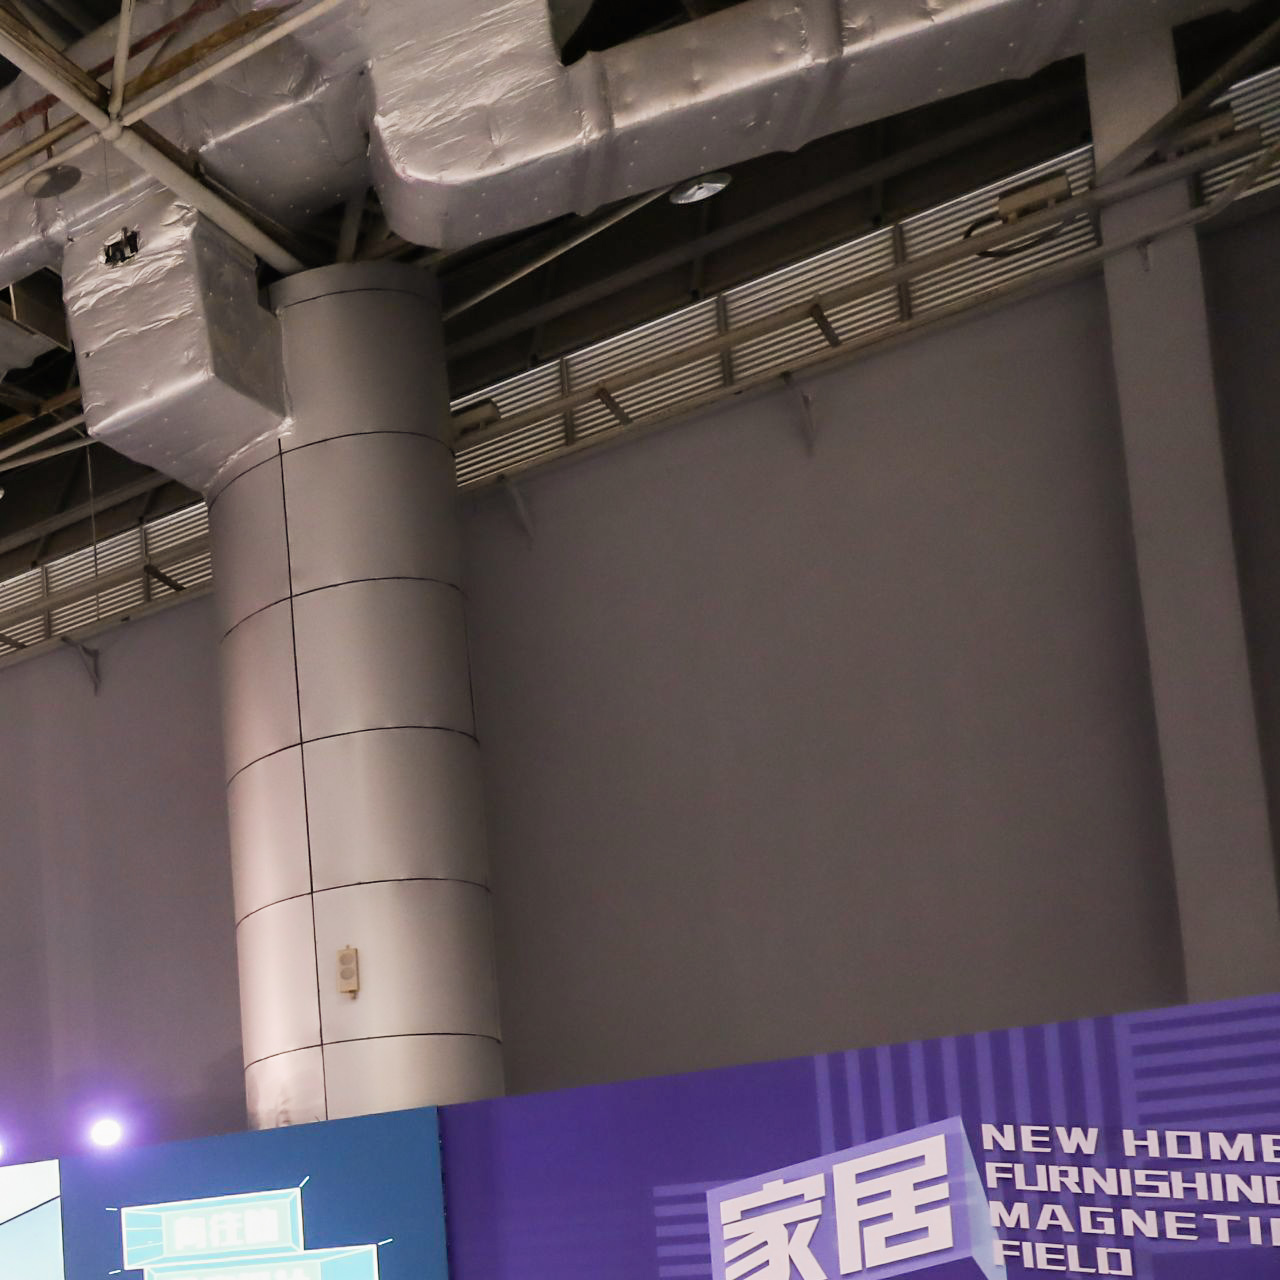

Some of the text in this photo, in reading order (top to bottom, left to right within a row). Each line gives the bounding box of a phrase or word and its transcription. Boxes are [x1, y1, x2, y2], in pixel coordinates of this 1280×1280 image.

[981, 1123, 1280, 1163] NEW HOME
[993, 1239, 1133, 1276] FIELD
